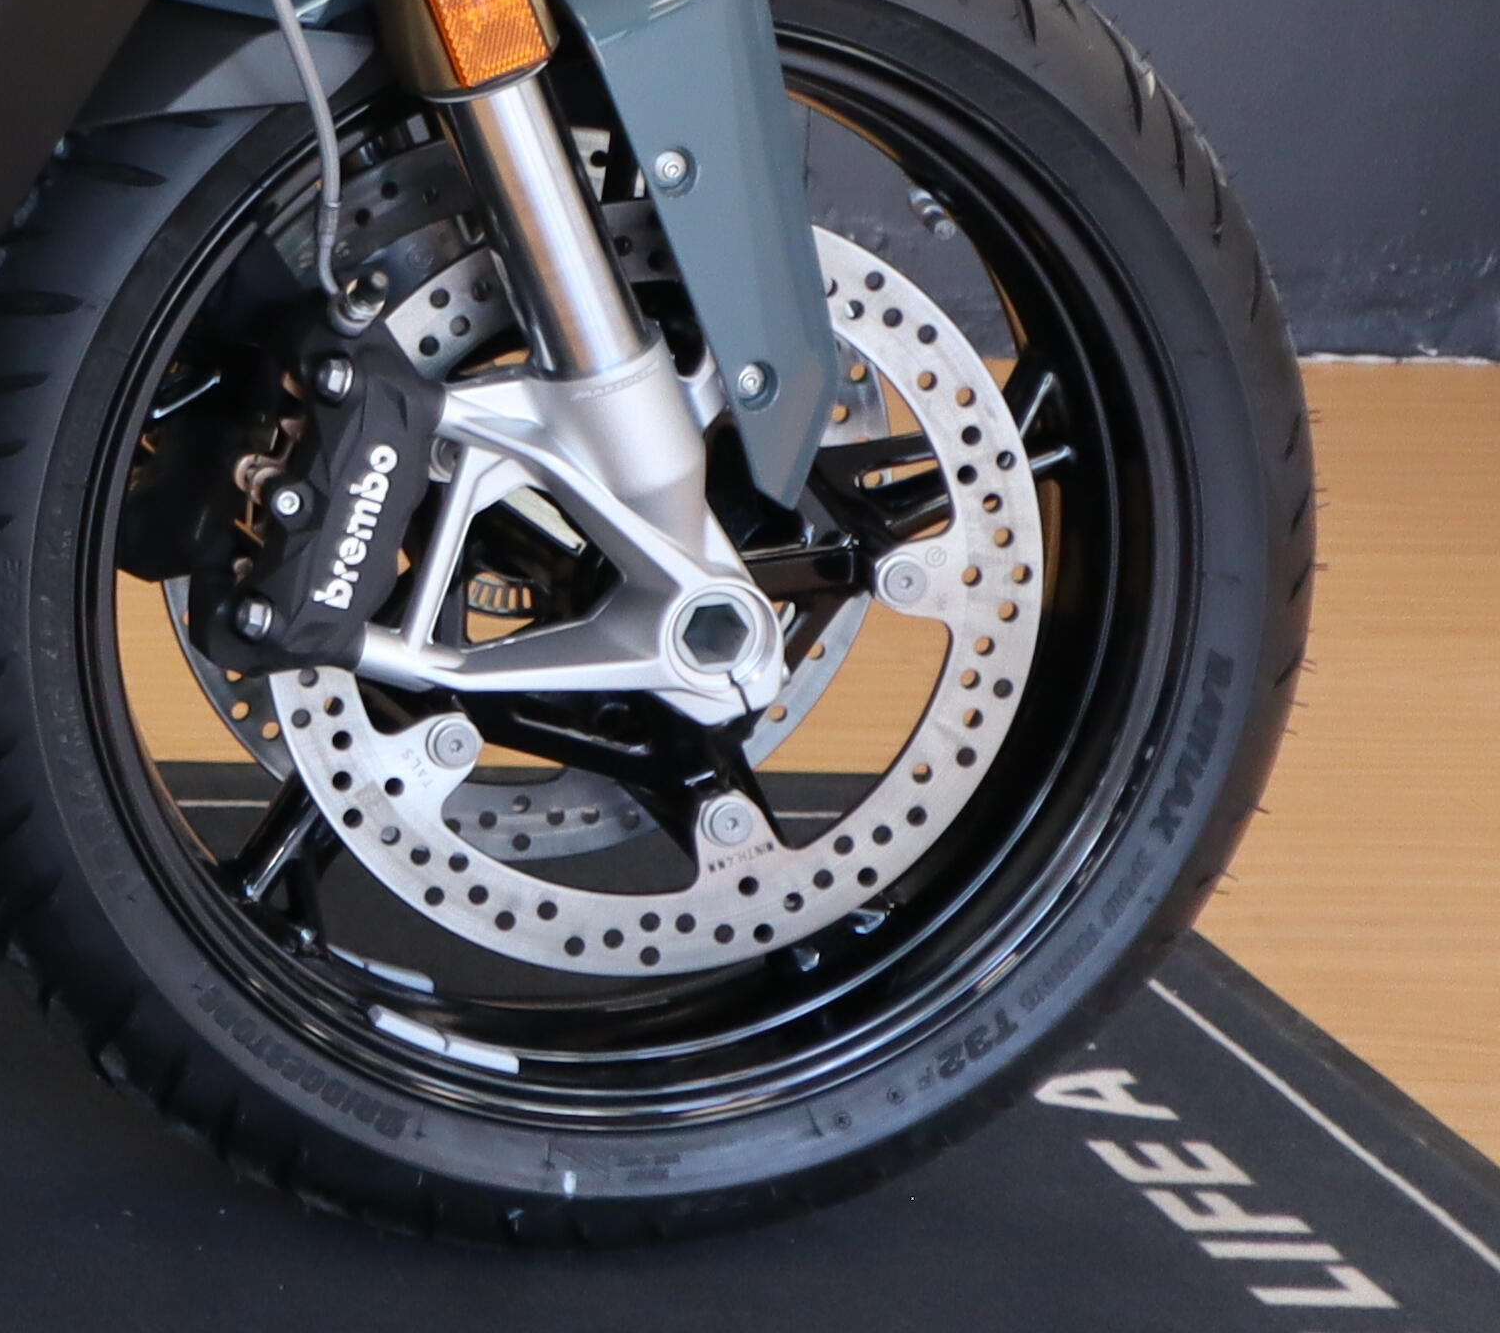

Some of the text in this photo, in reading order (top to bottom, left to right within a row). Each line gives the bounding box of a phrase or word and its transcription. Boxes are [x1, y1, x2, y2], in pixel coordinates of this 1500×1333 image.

[312, 443, 399, 611] brembo
[1033, 1068, 1402, 1310] LIFE A
